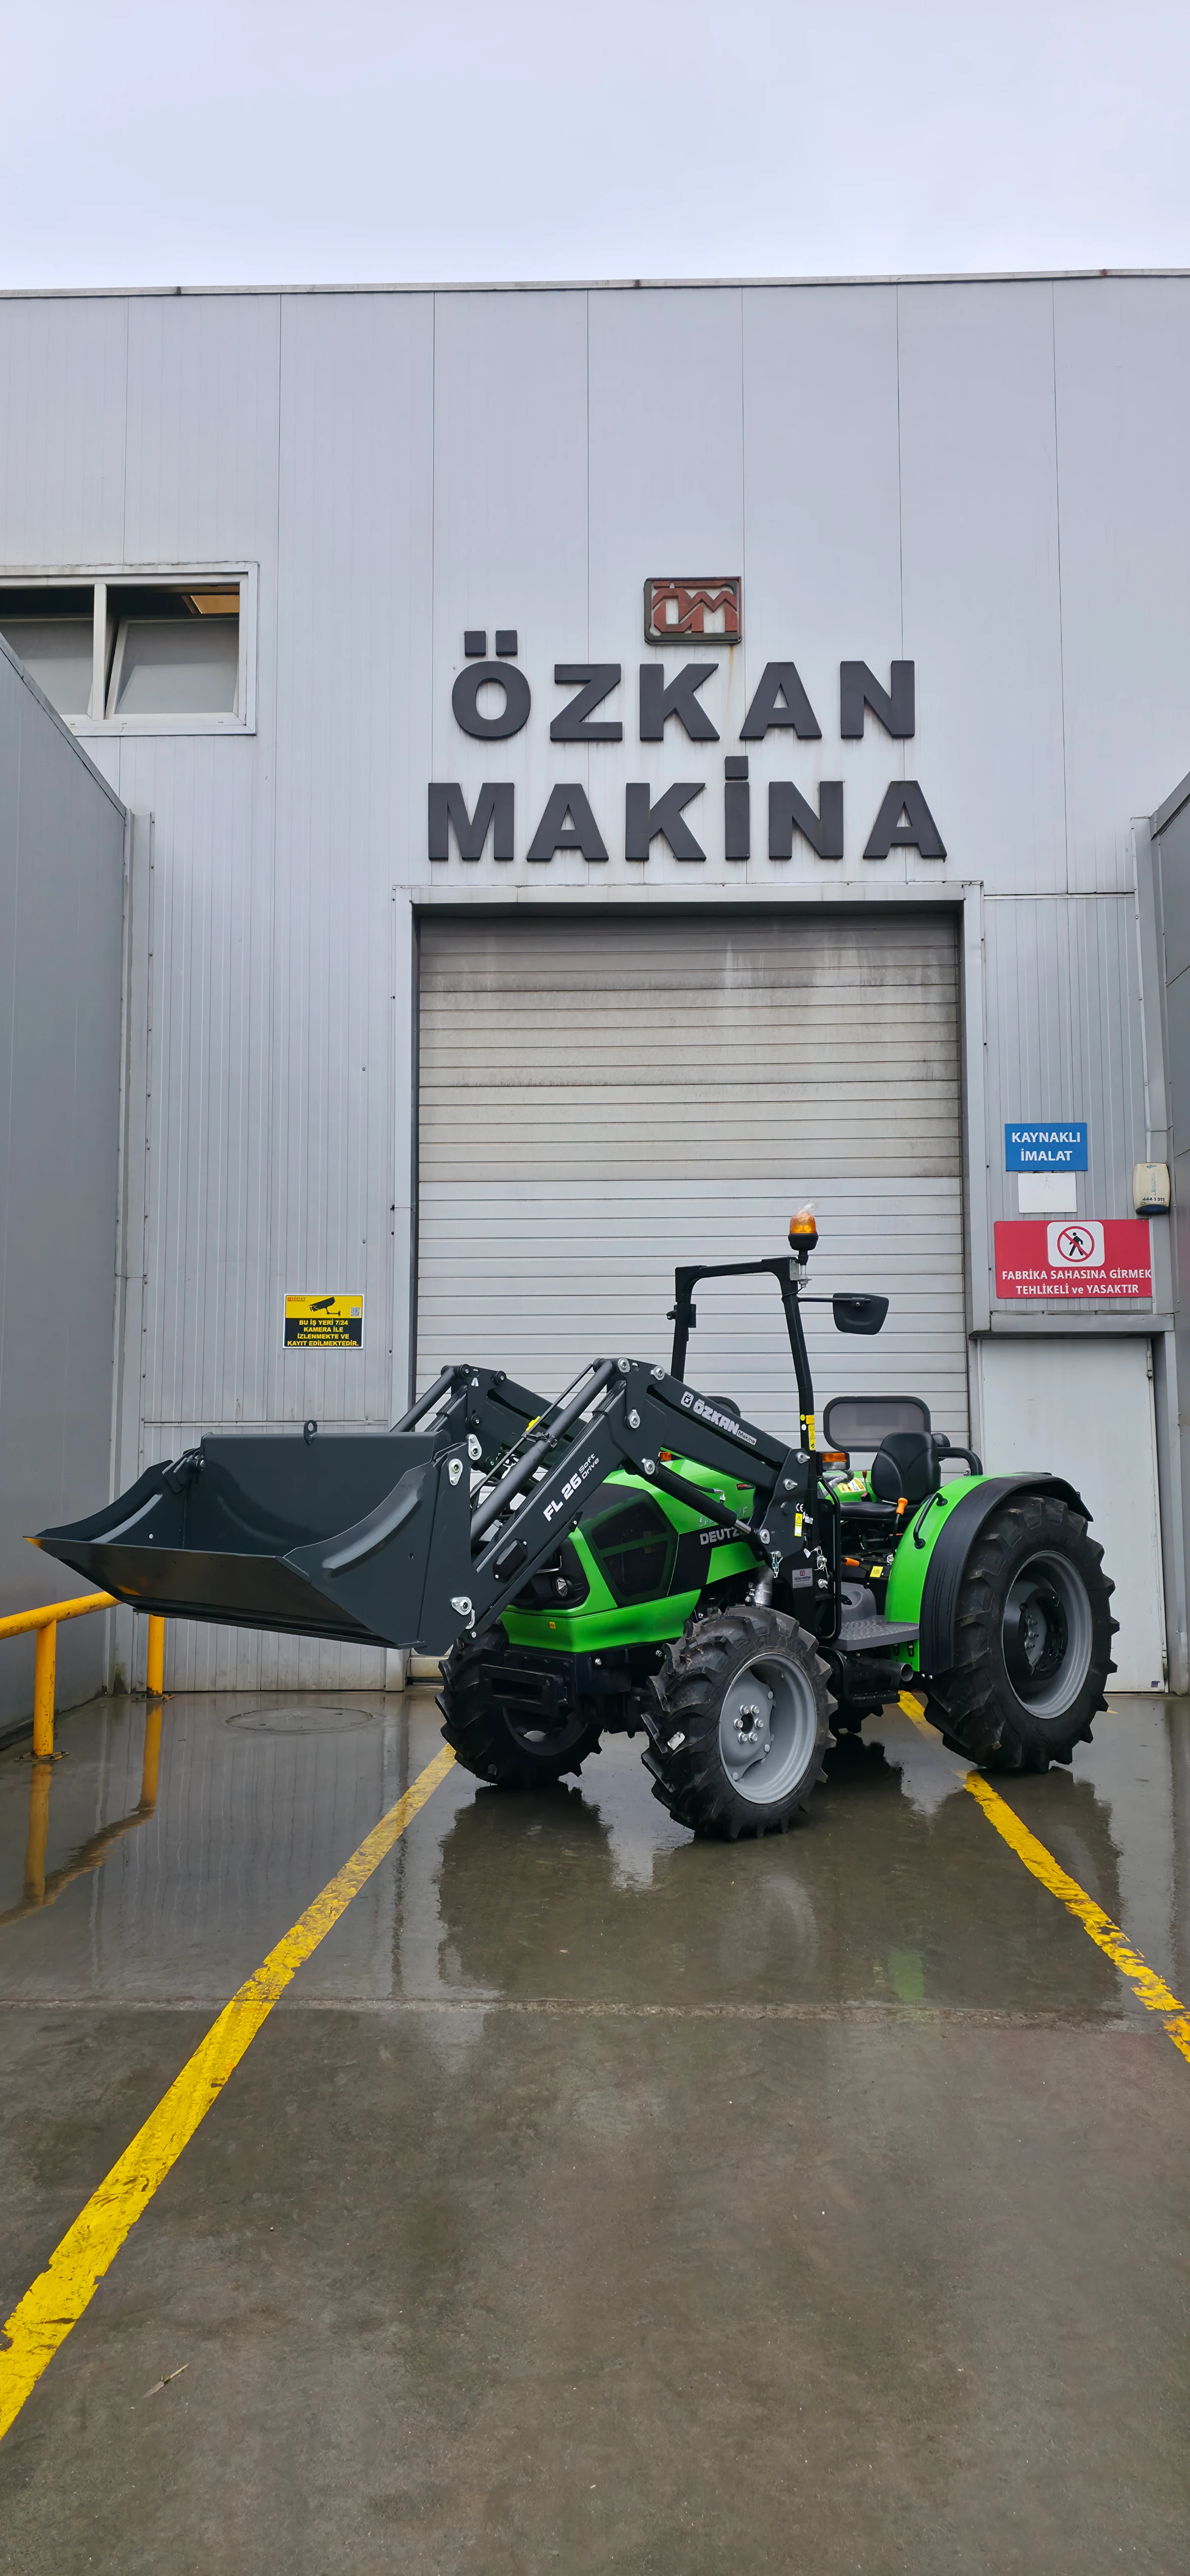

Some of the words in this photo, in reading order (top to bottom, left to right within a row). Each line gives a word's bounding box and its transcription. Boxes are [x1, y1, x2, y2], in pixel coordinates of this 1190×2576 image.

[452, 630, 915, 741] ÖZKAN
[428, 755, 948, 862] MAKİNA
[1012, 1132, 1080, 1143] KAYNAKLI
[1020, 1148, 1072, 1161] İMALAT
[1002, 1268, 1048, 1280] FABRİKA
[1051, 1269, 1107, 1279] SAHASINA
[1109, 1267, 1151, 1278] GİRMEK
[1016, 1283, 1069, 1294] TEHLİKELİ
[1086, 1284, 1139, 1294] YASAKTIR
[693, 1399, 740, 1435] ÖZKAN
[579, 1453, 595, 1474] Soft
[582, 1458, 599, 1480] Drive
[543, 1500, 564, 1522] FL
[561, 1473, 582, 1500] 26
[700, 1527, 740, 1545] DEUTZ
